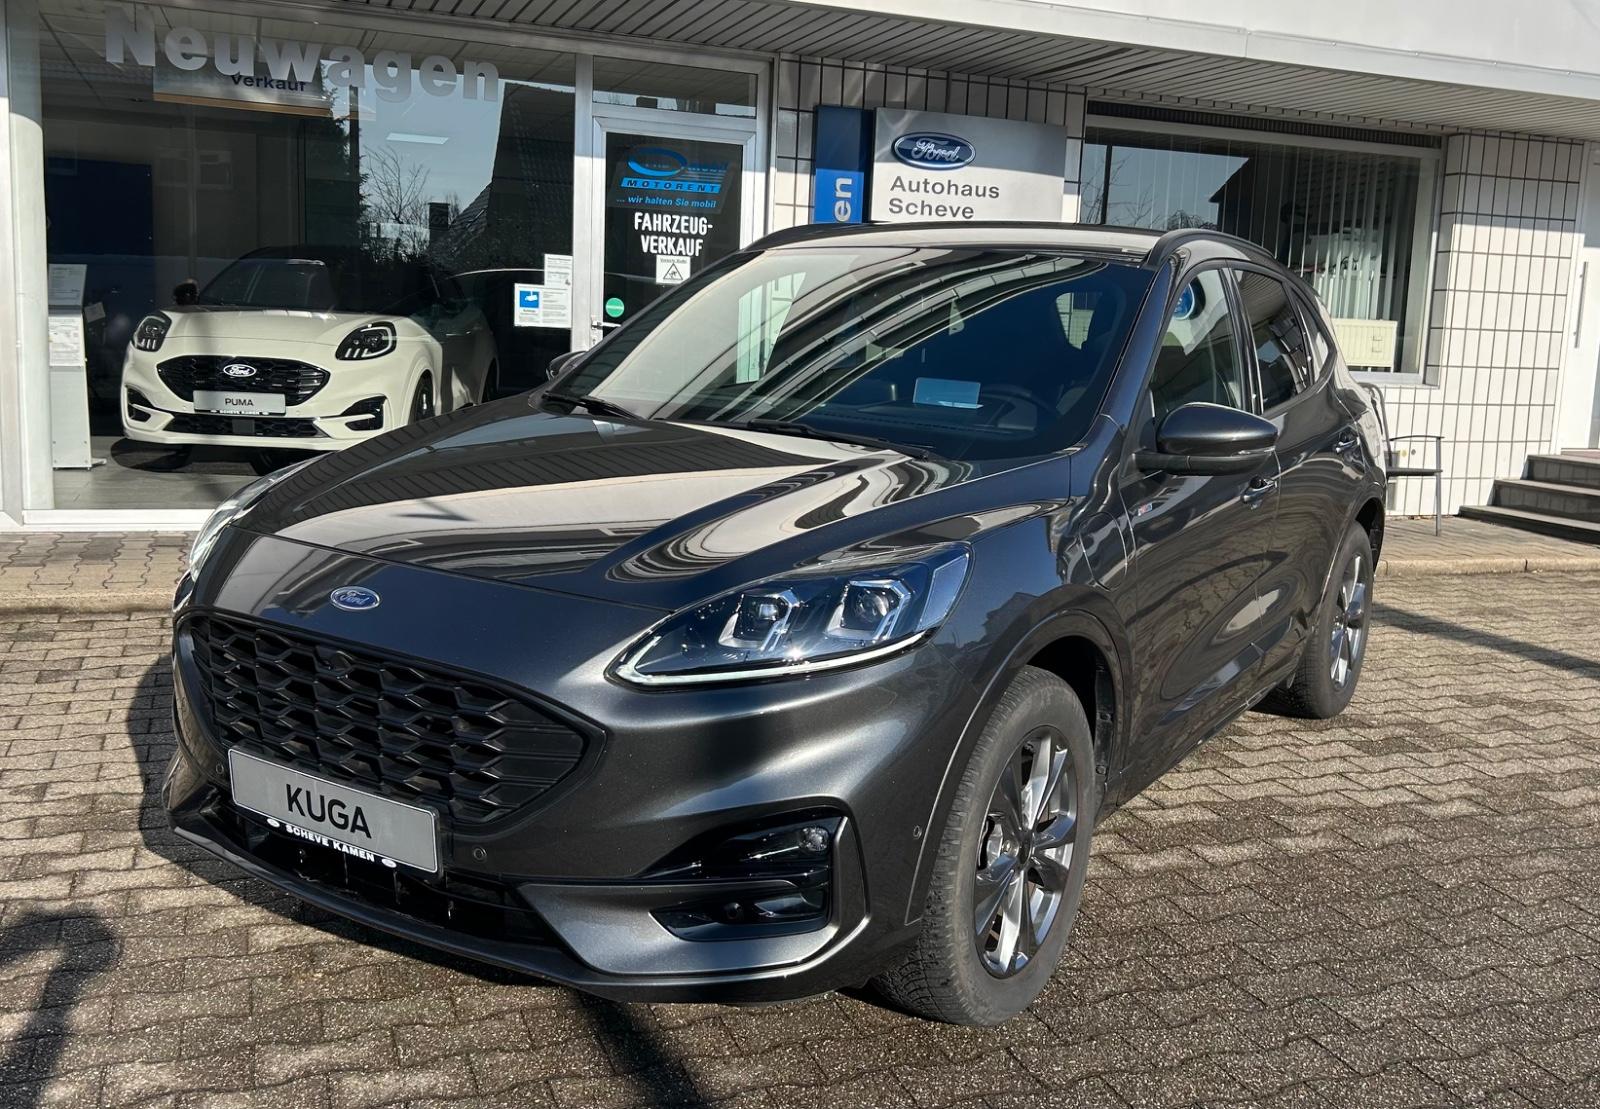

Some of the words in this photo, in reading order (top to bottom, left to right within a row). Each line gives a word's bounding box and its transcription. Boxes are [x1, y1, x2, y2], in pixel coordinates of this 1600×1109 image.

[104, 6, 500, 103] Neuwagen
[911, 137, 962, 162] Ford
[626, 179, 718, 193] MOTORENT
[890, 175, 1000, 199] Autohaus
[628, 196, 643, 204] wir
[645, 196, 673, 206] halten
[675, 197, 690, 207] Sie
[691, 200, 717, 209] mobil
[889, 197, 975, 220] Scheve
[634, 211, 714, 236] FAHRZEUG-
[640, 234, 704, 257] VERKAUF
[225, 397, 254, 407] PUMA
[286, 784, 372, 839] KUGA
[286, 824, 330, 847] SCHEVE
[332, 841, 375, 863] KAMEN
